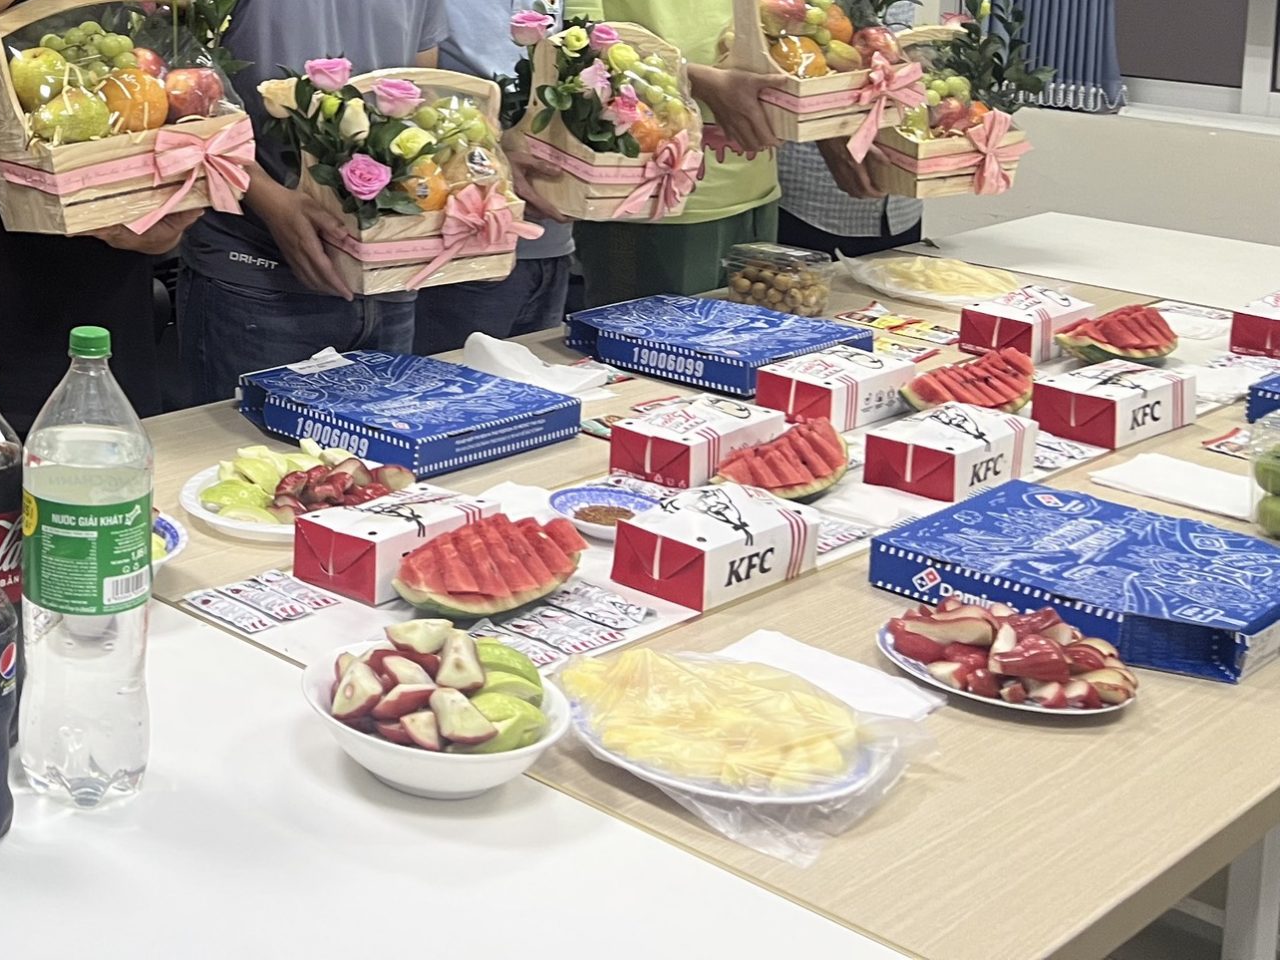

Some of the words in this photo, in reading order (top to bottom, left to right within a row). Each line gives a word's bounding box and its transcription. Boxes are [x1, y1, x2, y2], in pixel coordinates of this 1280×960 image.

[229, 251, 279, 269] DRI-FIT
[632, 346, 704, 378] 19006099
[1129, 400, 1161, 431] KFC
[296, 417, 369, 458] 19006099
[969, 452, 1004, 487] KFC
[78, 514, 98, 527] GIẢI
[100, 514, 123, 527] KHÁT
[0, 574, 20, 588] BẢN
[724, 546, 775, 588] KFC
